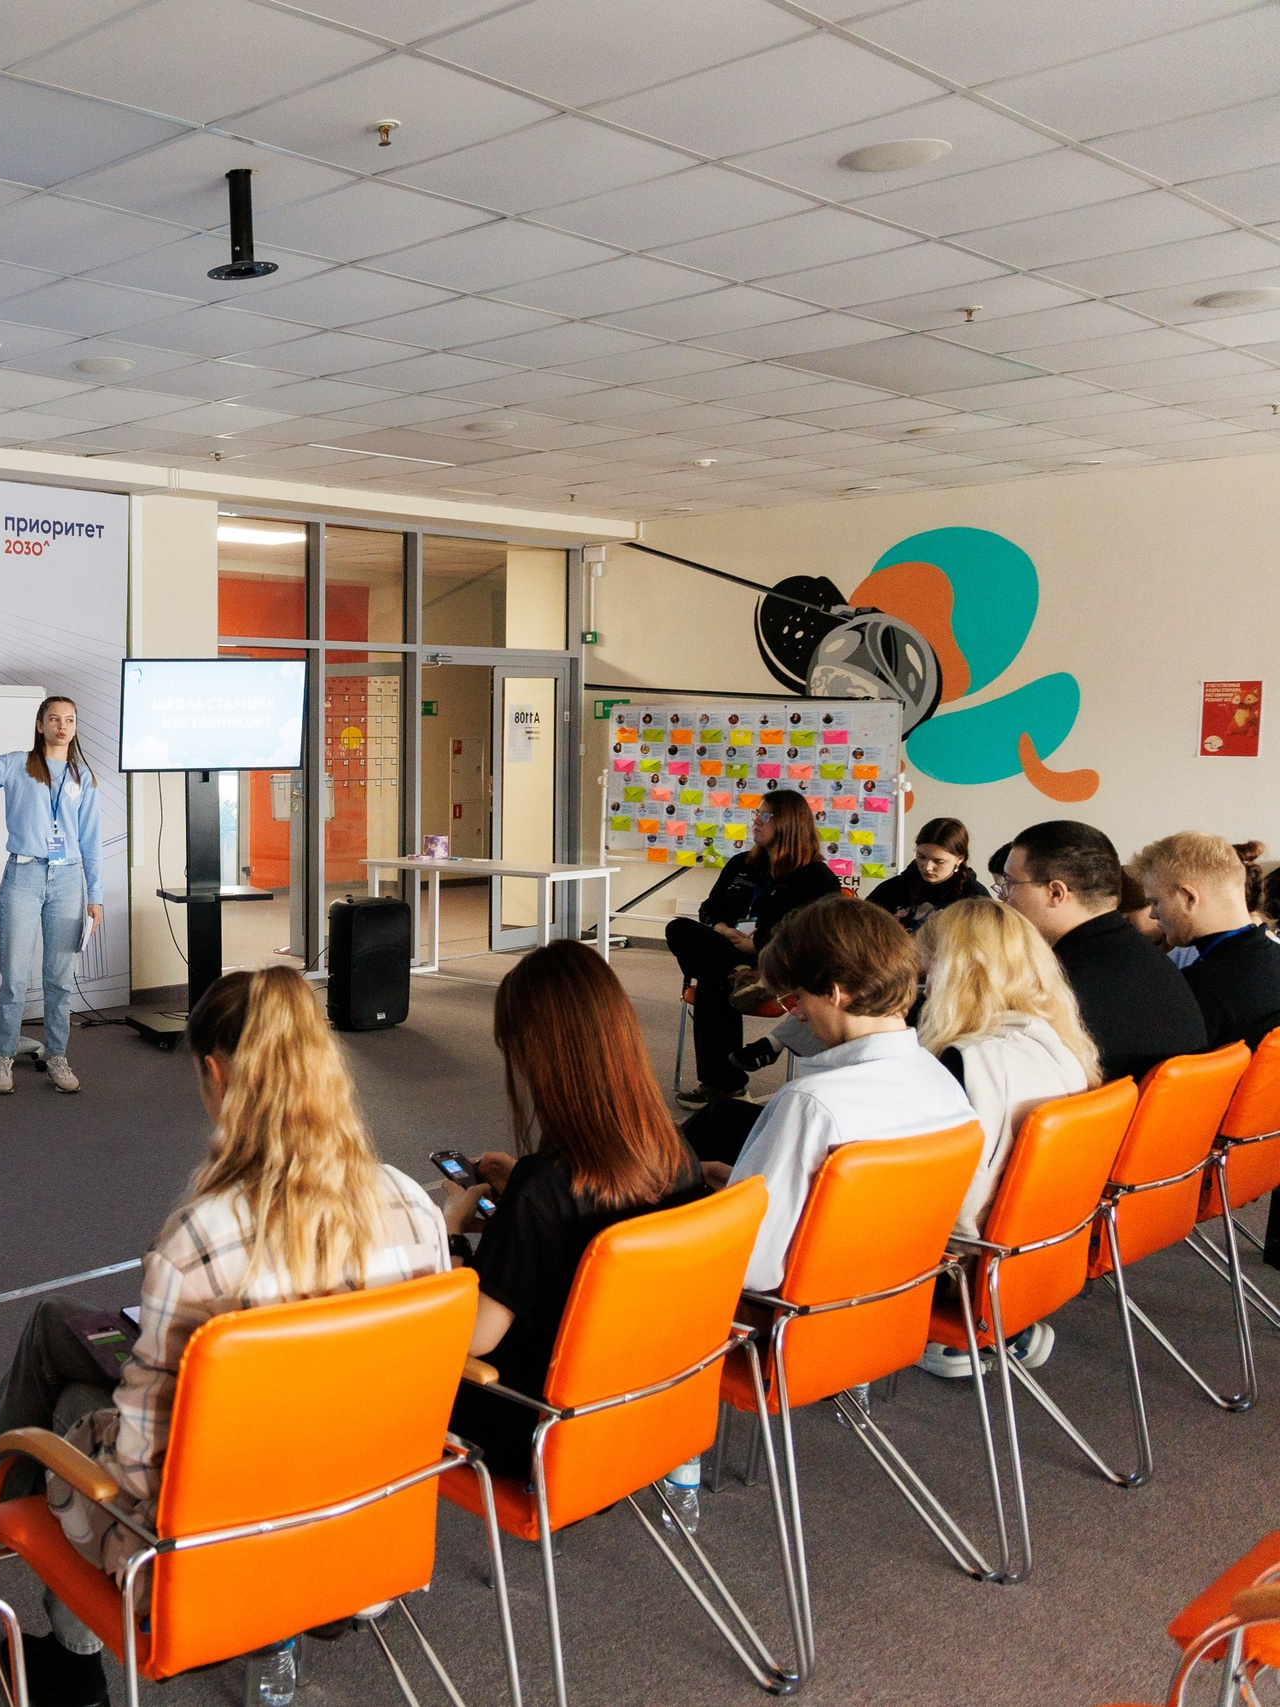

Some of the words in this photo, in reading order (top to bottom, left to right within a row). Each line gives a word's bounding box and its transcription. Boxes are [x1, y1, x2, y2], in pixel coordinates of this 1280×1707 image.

[4, 514, 105, 540] приоритет
[151, 697, 204, 711] ШКОЛА
[206, 696, 277, 710] СТАРШИХ
